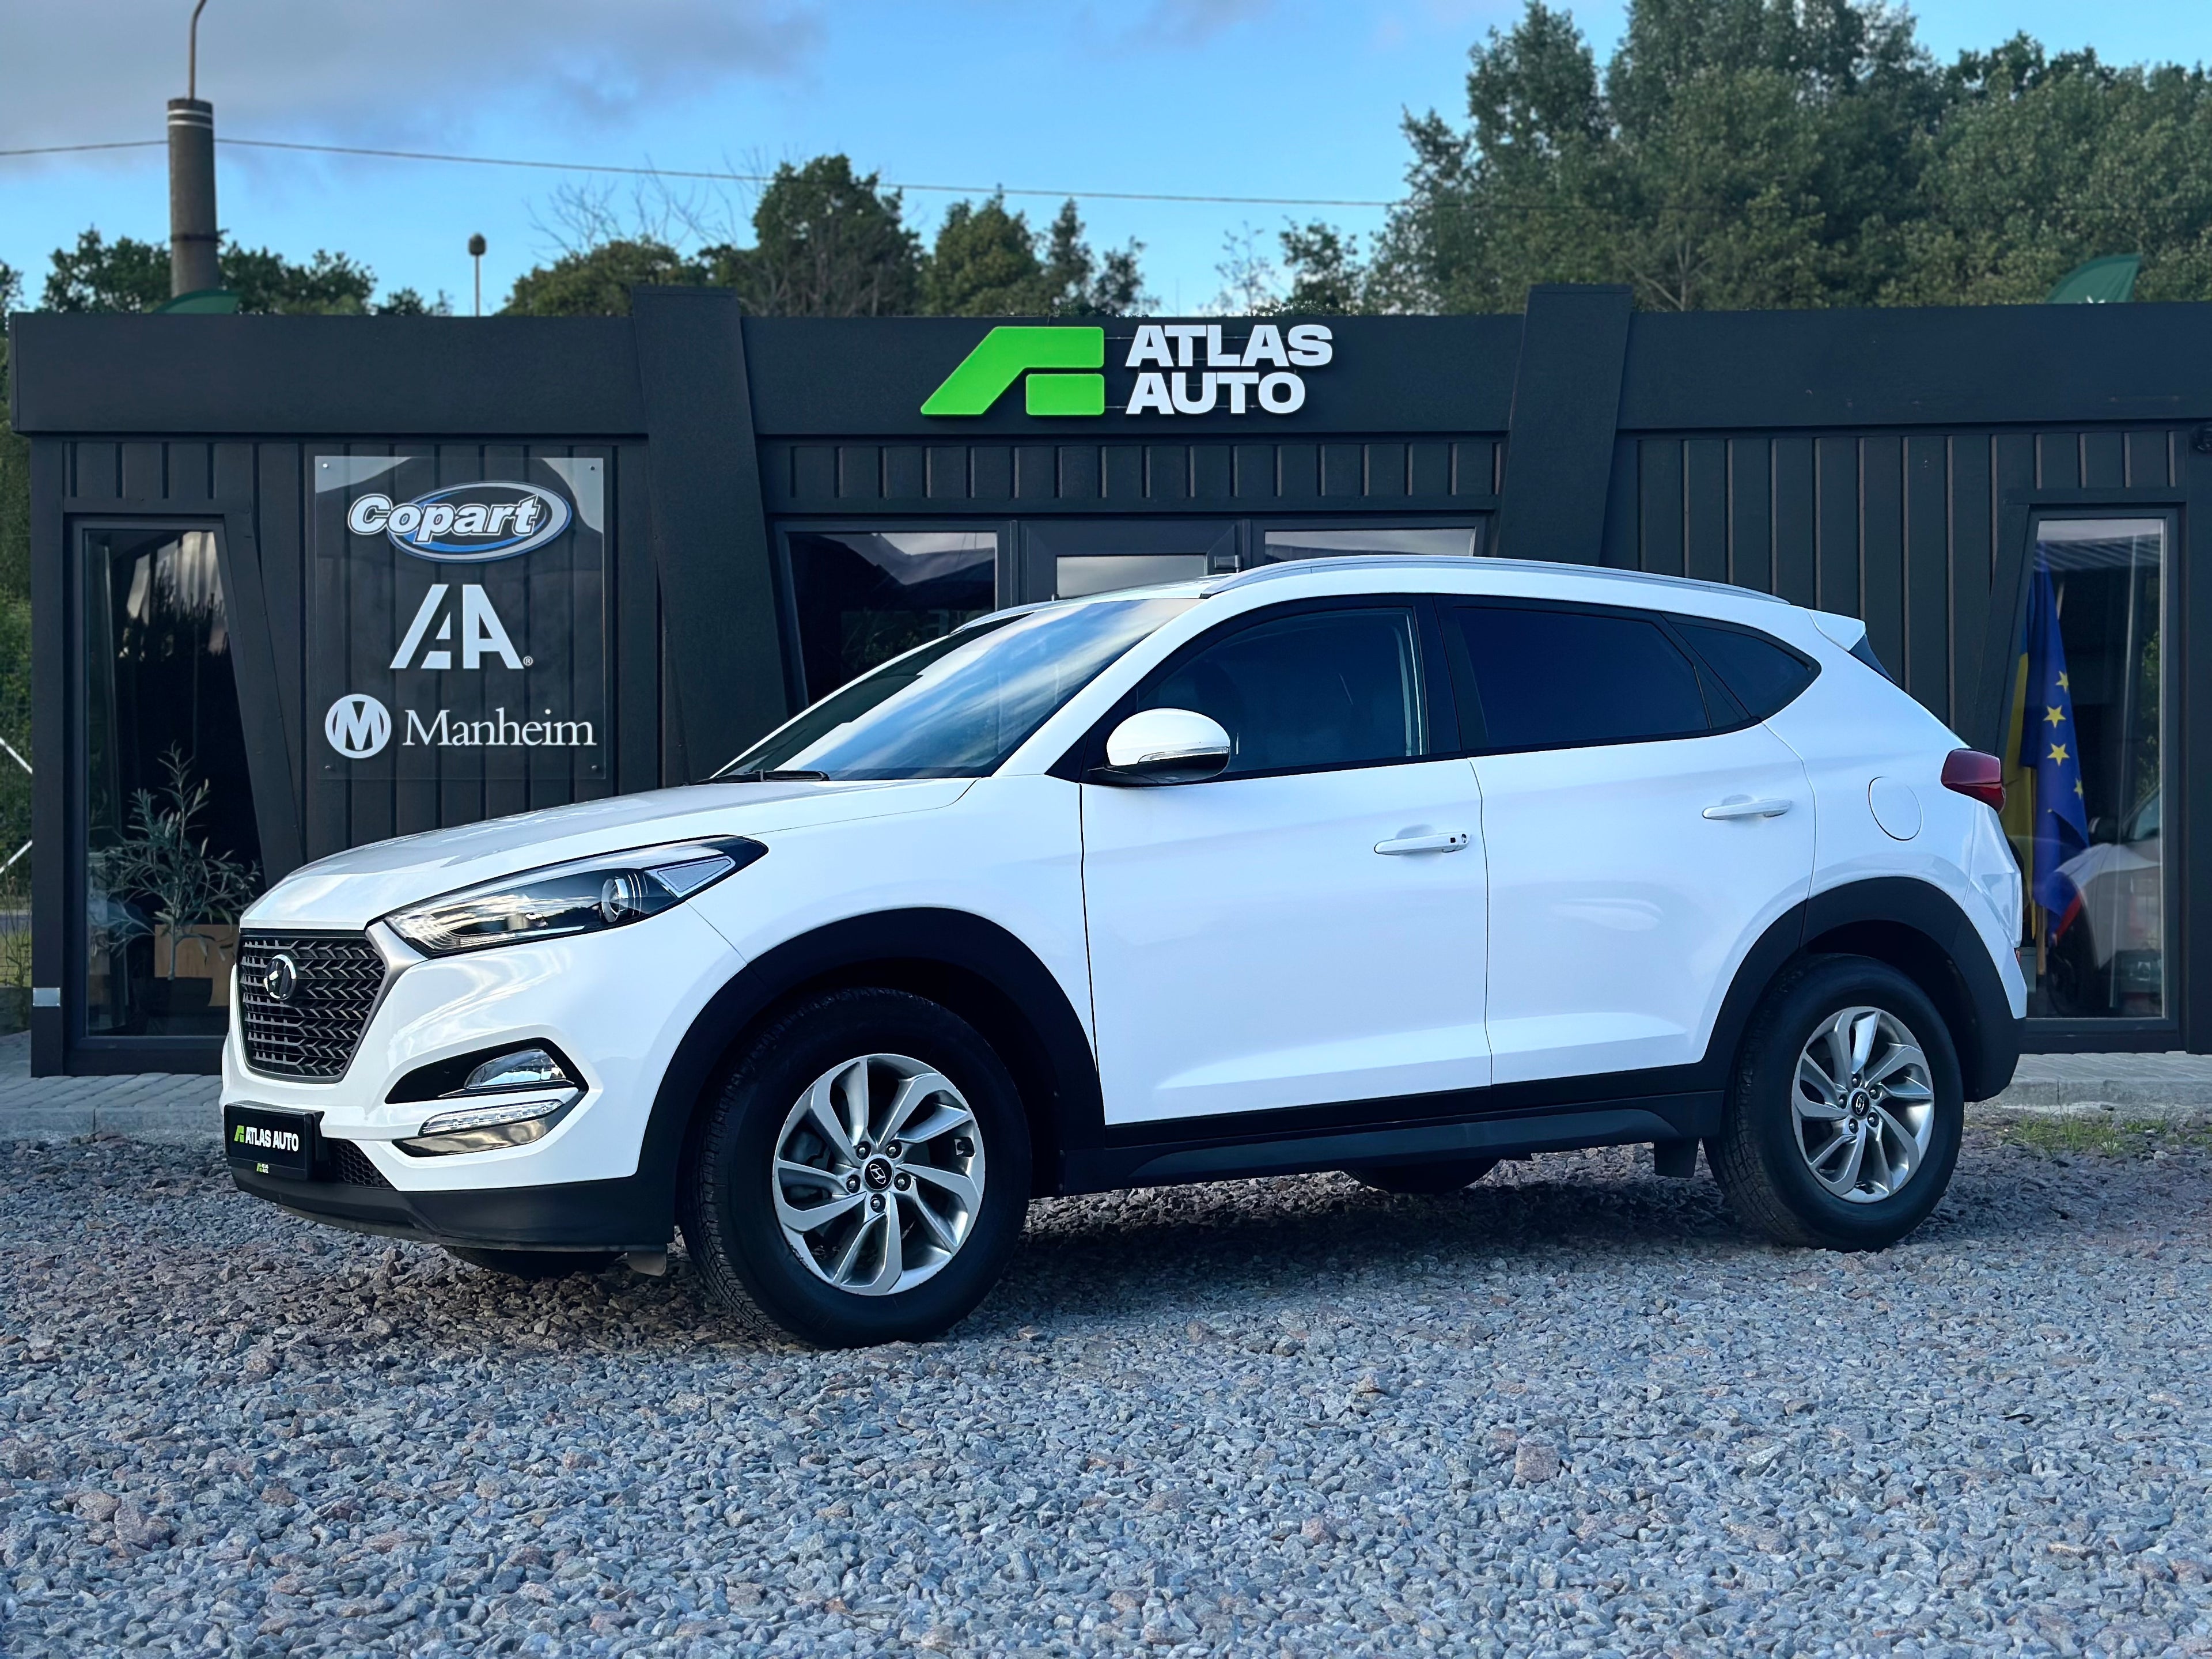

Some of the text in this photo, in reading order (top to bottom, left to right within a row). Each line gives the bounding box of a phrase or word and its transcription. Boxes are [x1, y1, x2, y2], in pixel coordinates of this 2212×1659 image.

[1125, 324, 1332, 366] ATLAS
[1125, 372, 1305, 414] AUTO
[348, 494, 540, 543] Copart
[403, 707, 597, 745] Manheim
[245, 1126, 299, 1152] ATLAS AUTO
